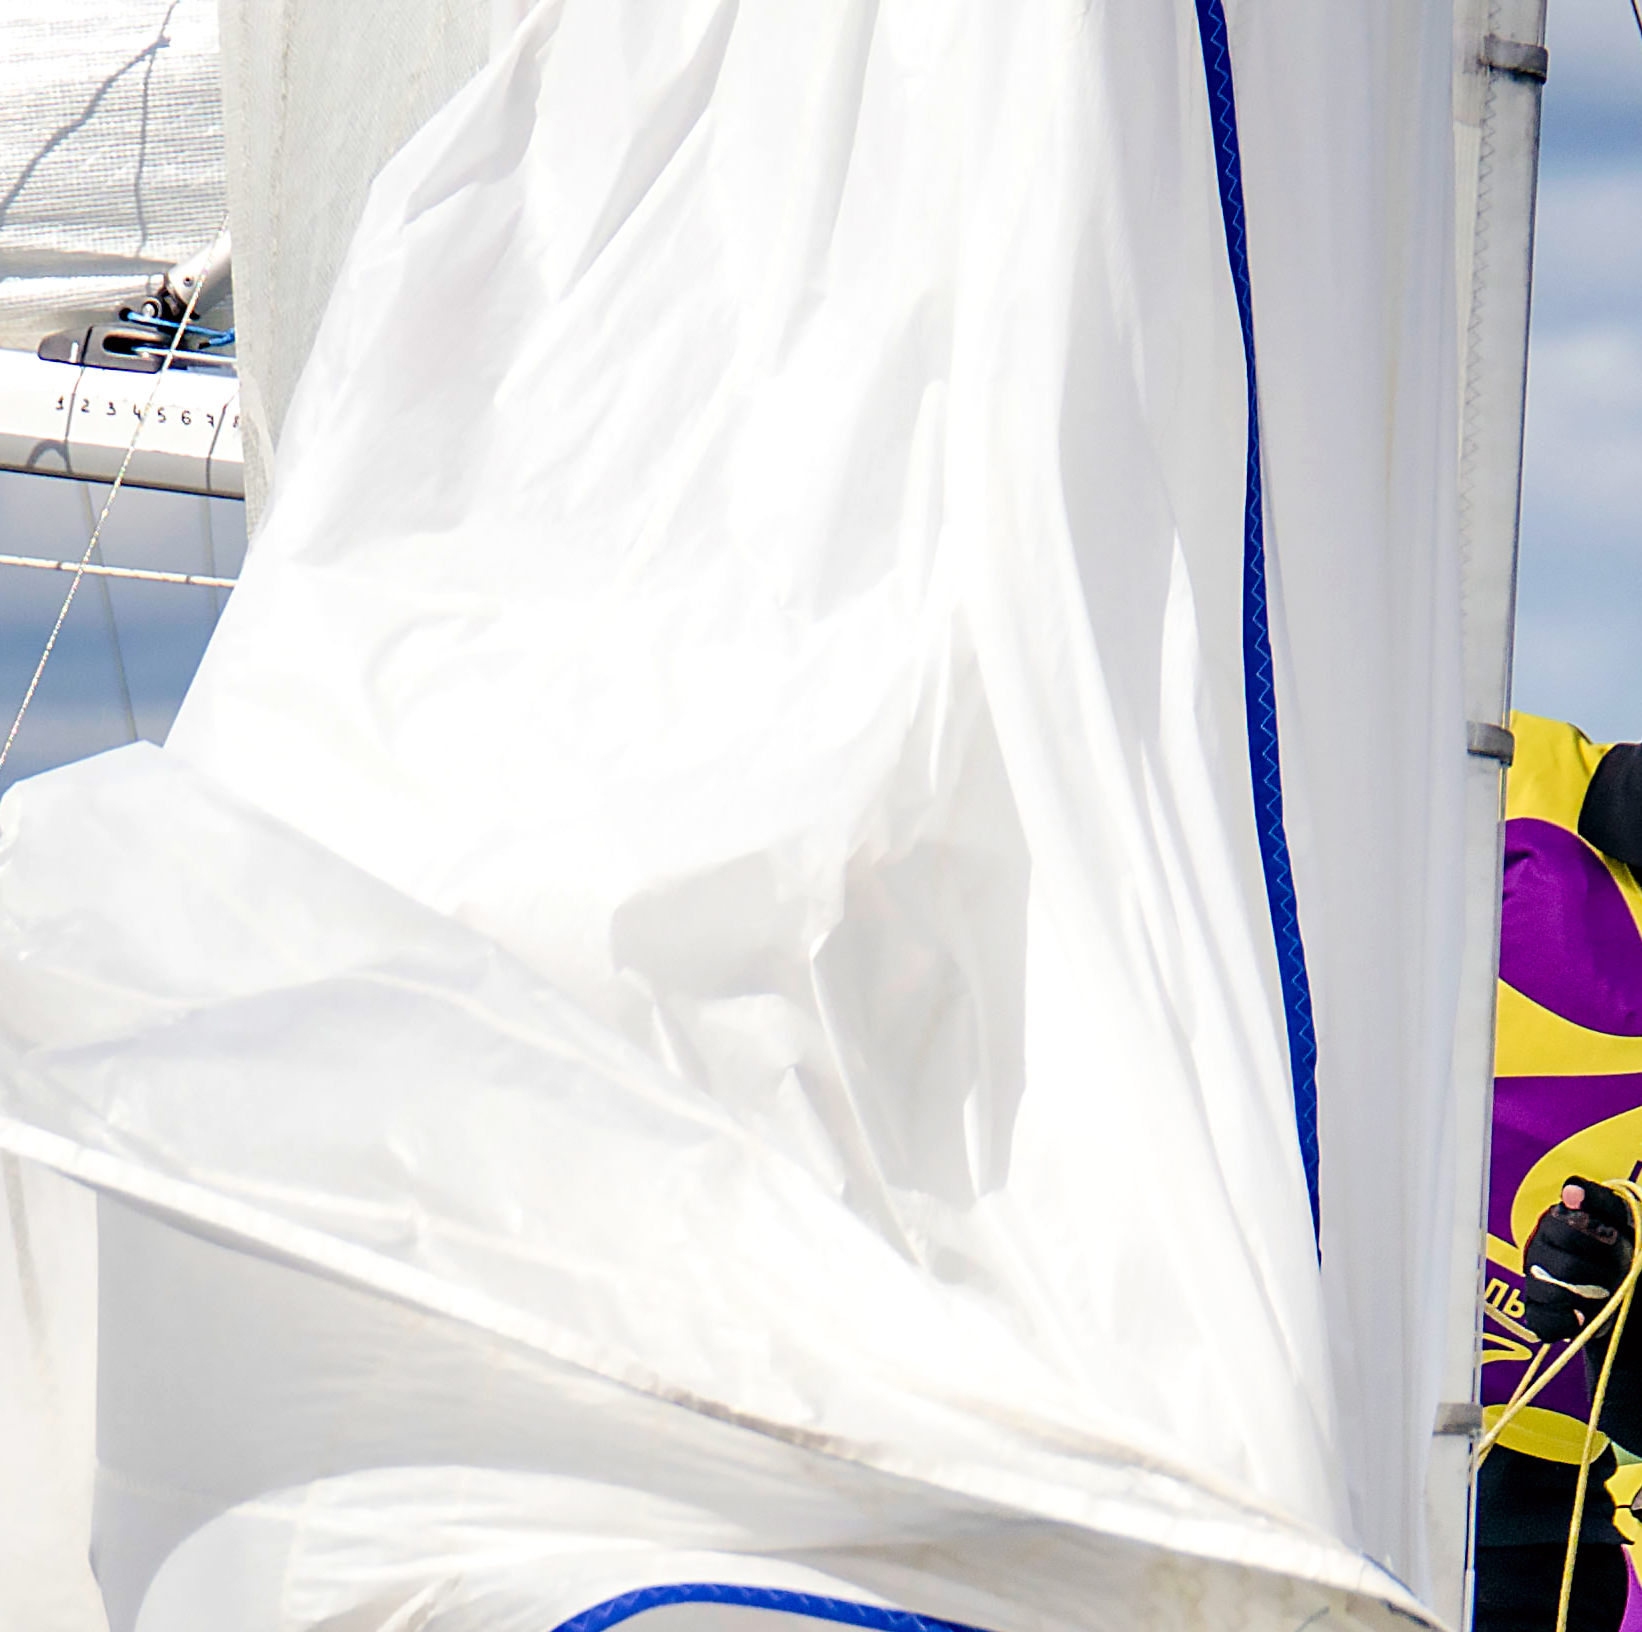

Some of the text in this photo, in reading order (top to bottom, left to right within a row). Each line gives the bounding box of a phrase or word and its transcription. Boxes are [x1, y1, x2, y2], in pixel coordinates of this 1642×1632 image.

[80, 398, 91, 414] 2
[105, 401, 117, 417] 3
[132, 404, 144, 423] 4
[156, 407, 168, 424] 5
[180, 410, 193, 426] 6
